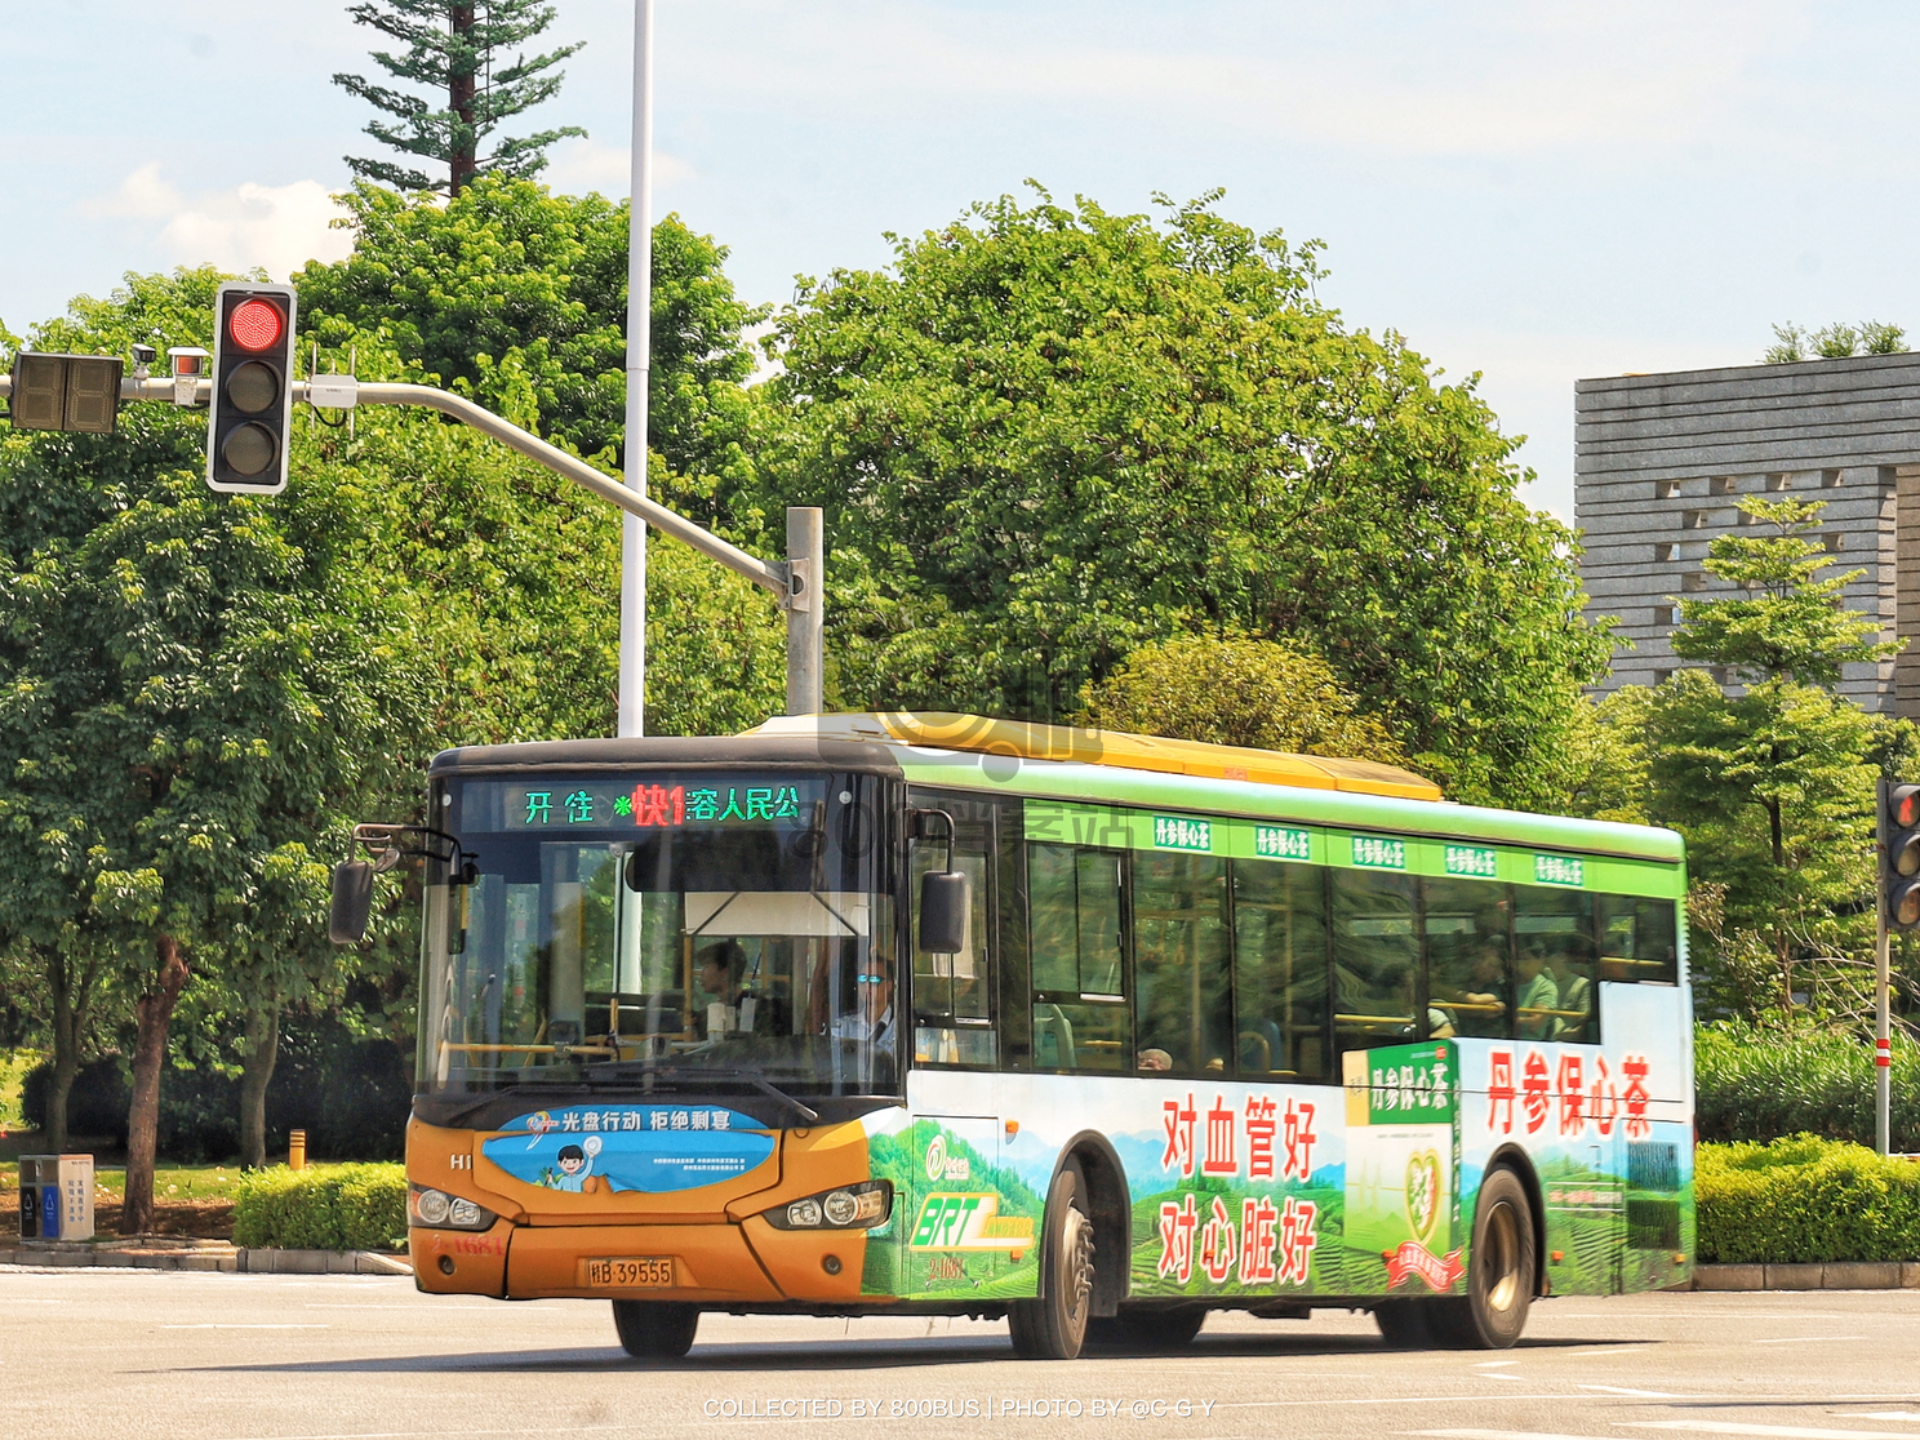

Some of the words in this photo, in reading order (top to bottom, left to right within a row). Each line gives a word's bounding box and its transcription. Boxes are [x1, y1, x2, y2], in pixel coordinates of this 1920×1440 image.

[525, 791, 594, 823] 开往
[1156, 818, 1209, 849] 丹参保心茶
[1257, 828, 1308, 858] 丹参保心茶
[1371, 1062, 1450, 1111] 丹参保心茶
[1488, 1050, 1651, 1138] 丹参保心茶
[562, 1111, 640, 1132] 光盘行动
[650, 1110, 730, 1131] 拒绝剩宴
[1162, 1095, 1317, 1180] 对血管好
[450, 1154, 472, 1170] HI
[911, 1197, 981, 1246] BRT
[1159, 1195, 1318, 1284] 对心脏好
